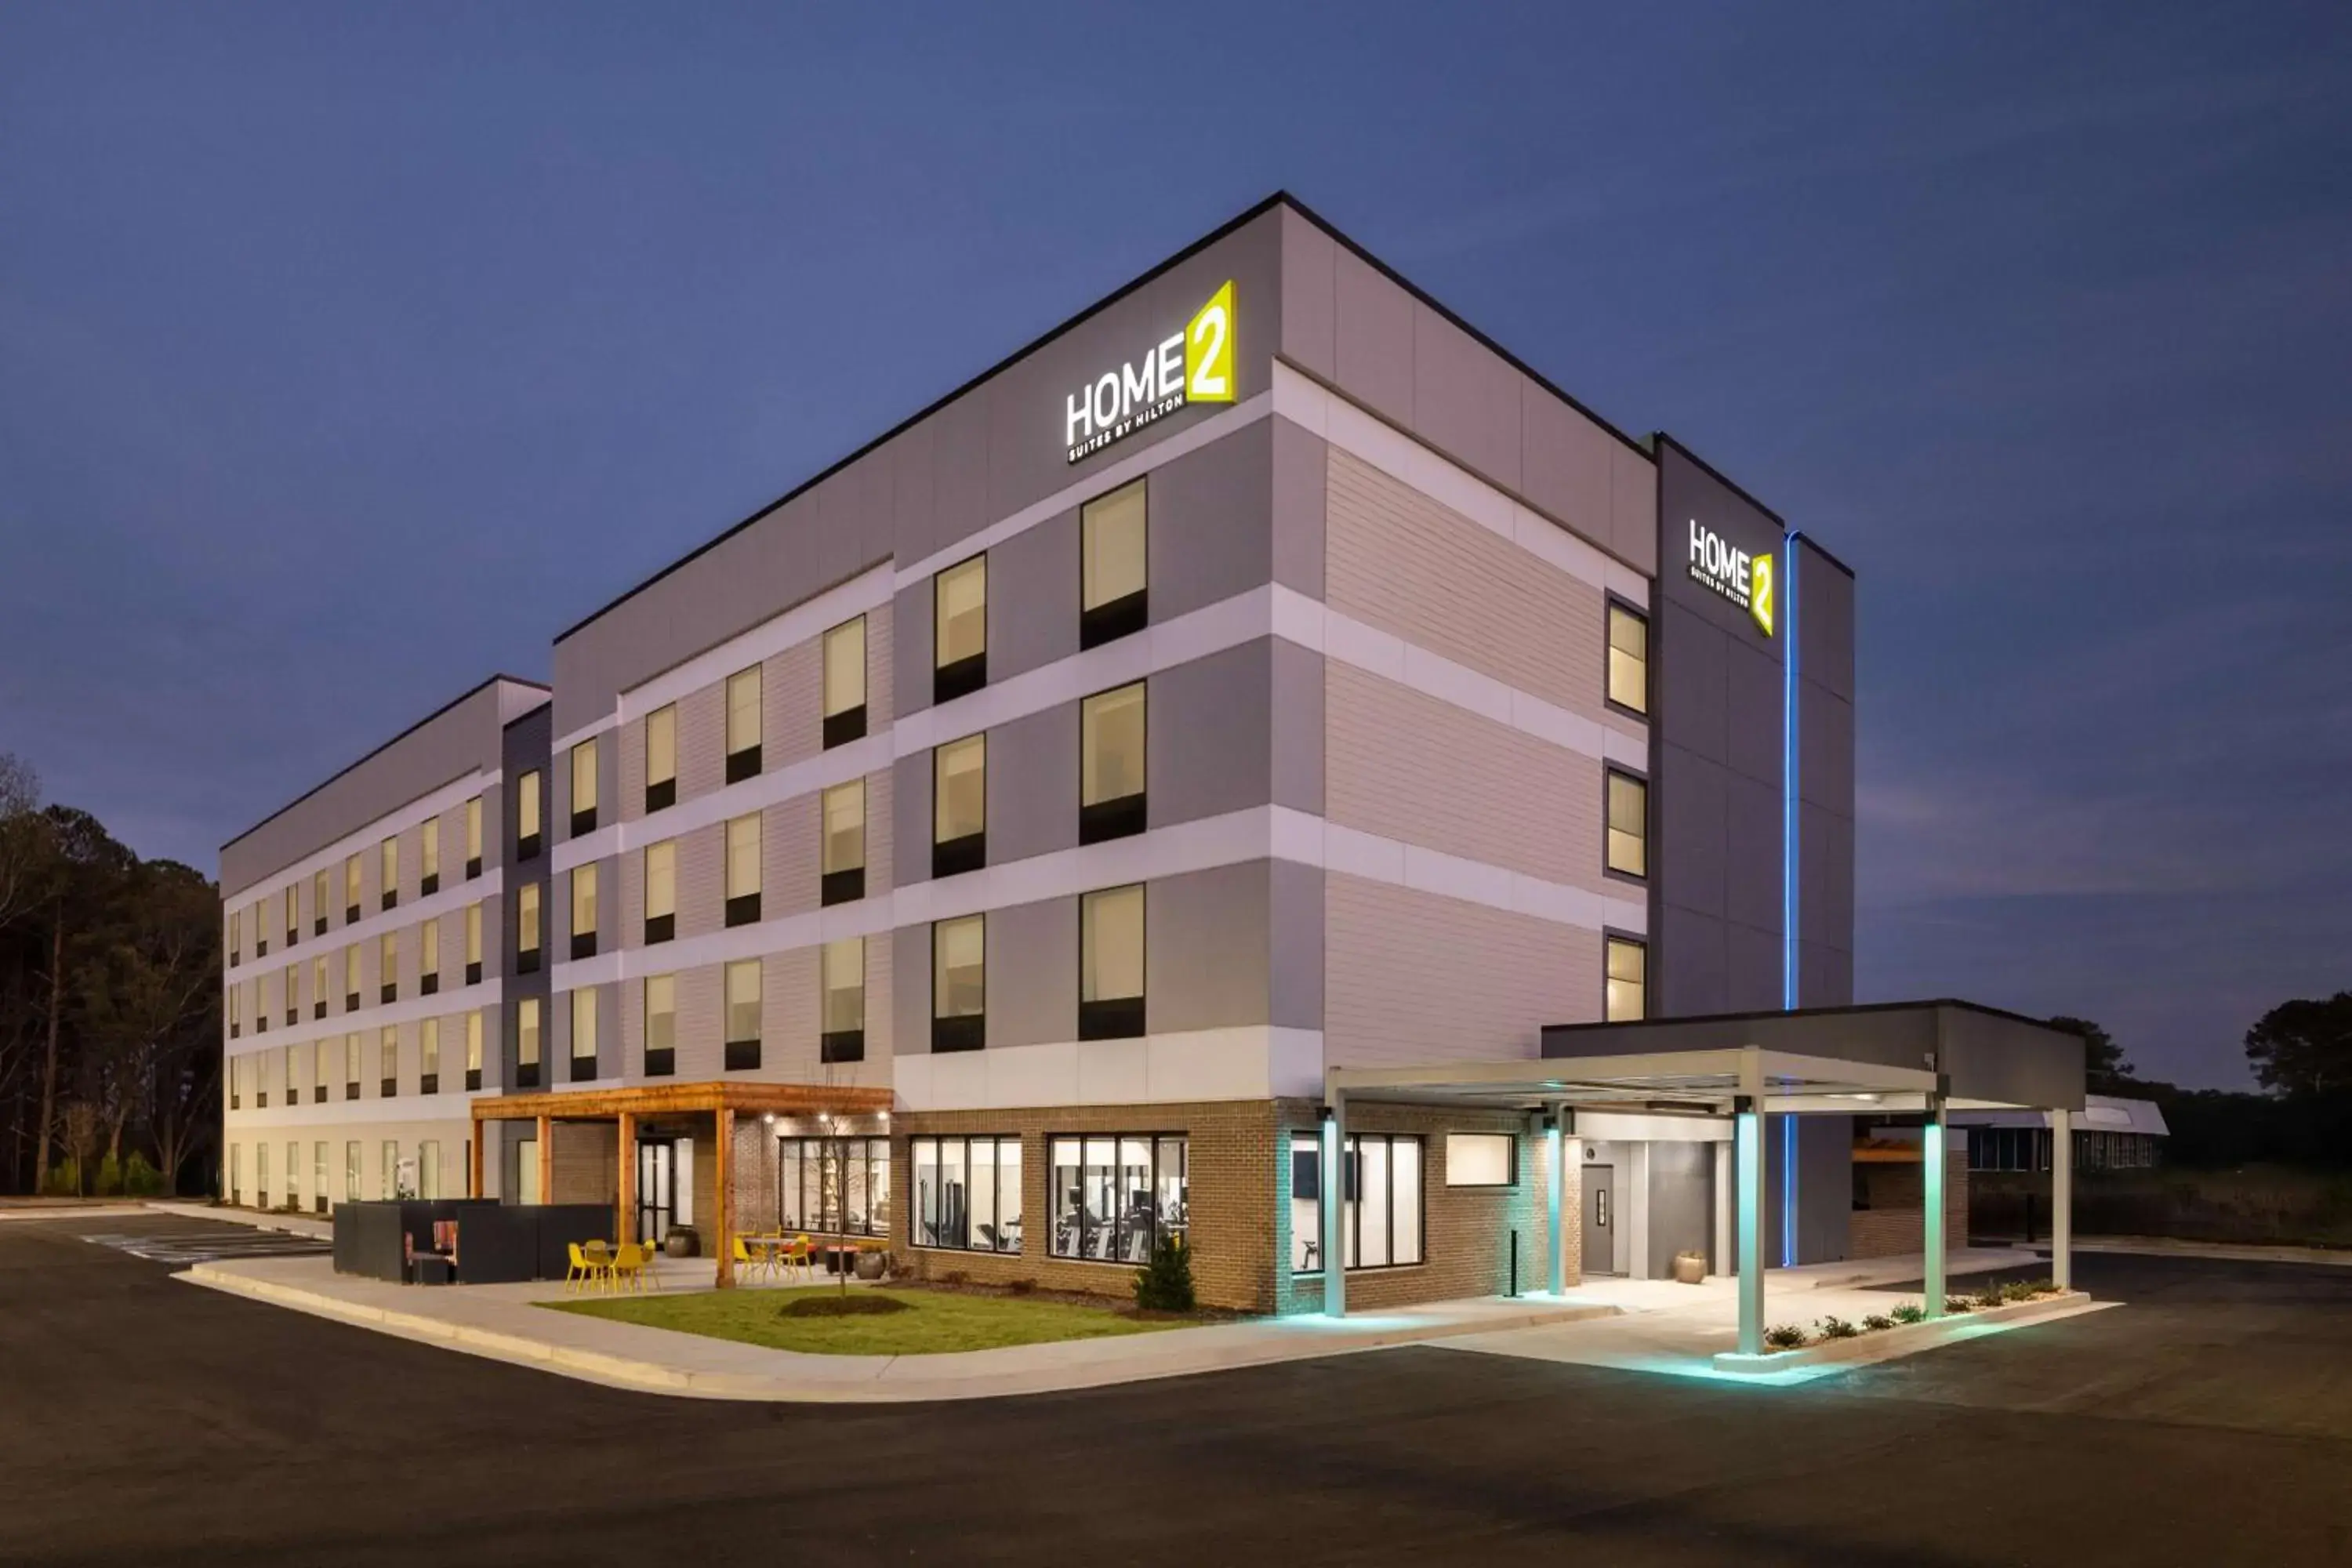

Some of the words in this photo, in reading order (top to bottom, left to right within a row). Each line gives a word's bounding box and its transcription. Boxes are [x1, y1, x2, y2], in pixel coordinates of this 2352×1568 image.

[1069, 430, 1111, 462] SUITES
[1116, 420, 1131, 437] BY
[1136, 394, 1182, 427] HILTON
